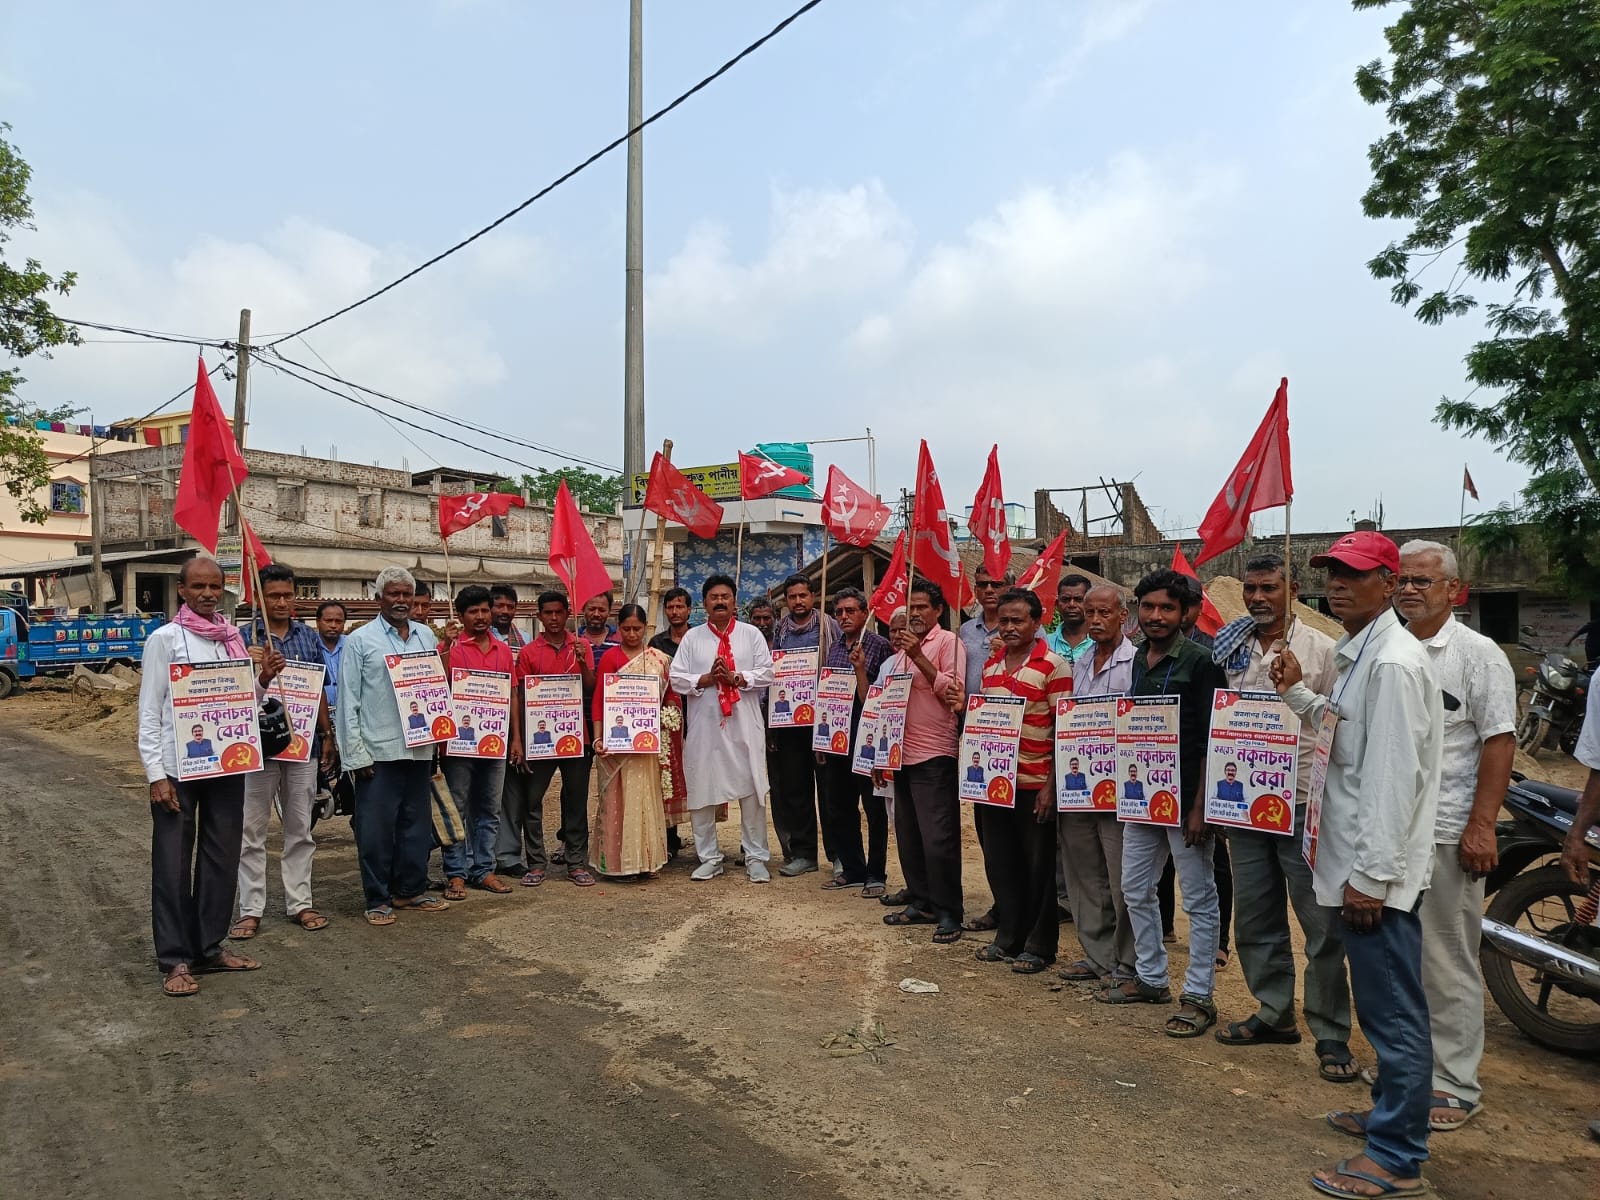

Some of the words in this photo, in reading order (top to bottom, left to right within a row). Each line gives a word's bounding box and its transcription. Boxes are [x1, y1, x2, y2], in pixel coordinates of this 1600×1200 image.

[217, 723, 250, 741] বেরা
[987, 757, 1011, 773] বেরা
[1237, 748, 1293, 772] নকুলচন্দ্র
[1146, 769, 1173, 787] বেরা
[1250, 770, 1286, 791] বেরা
